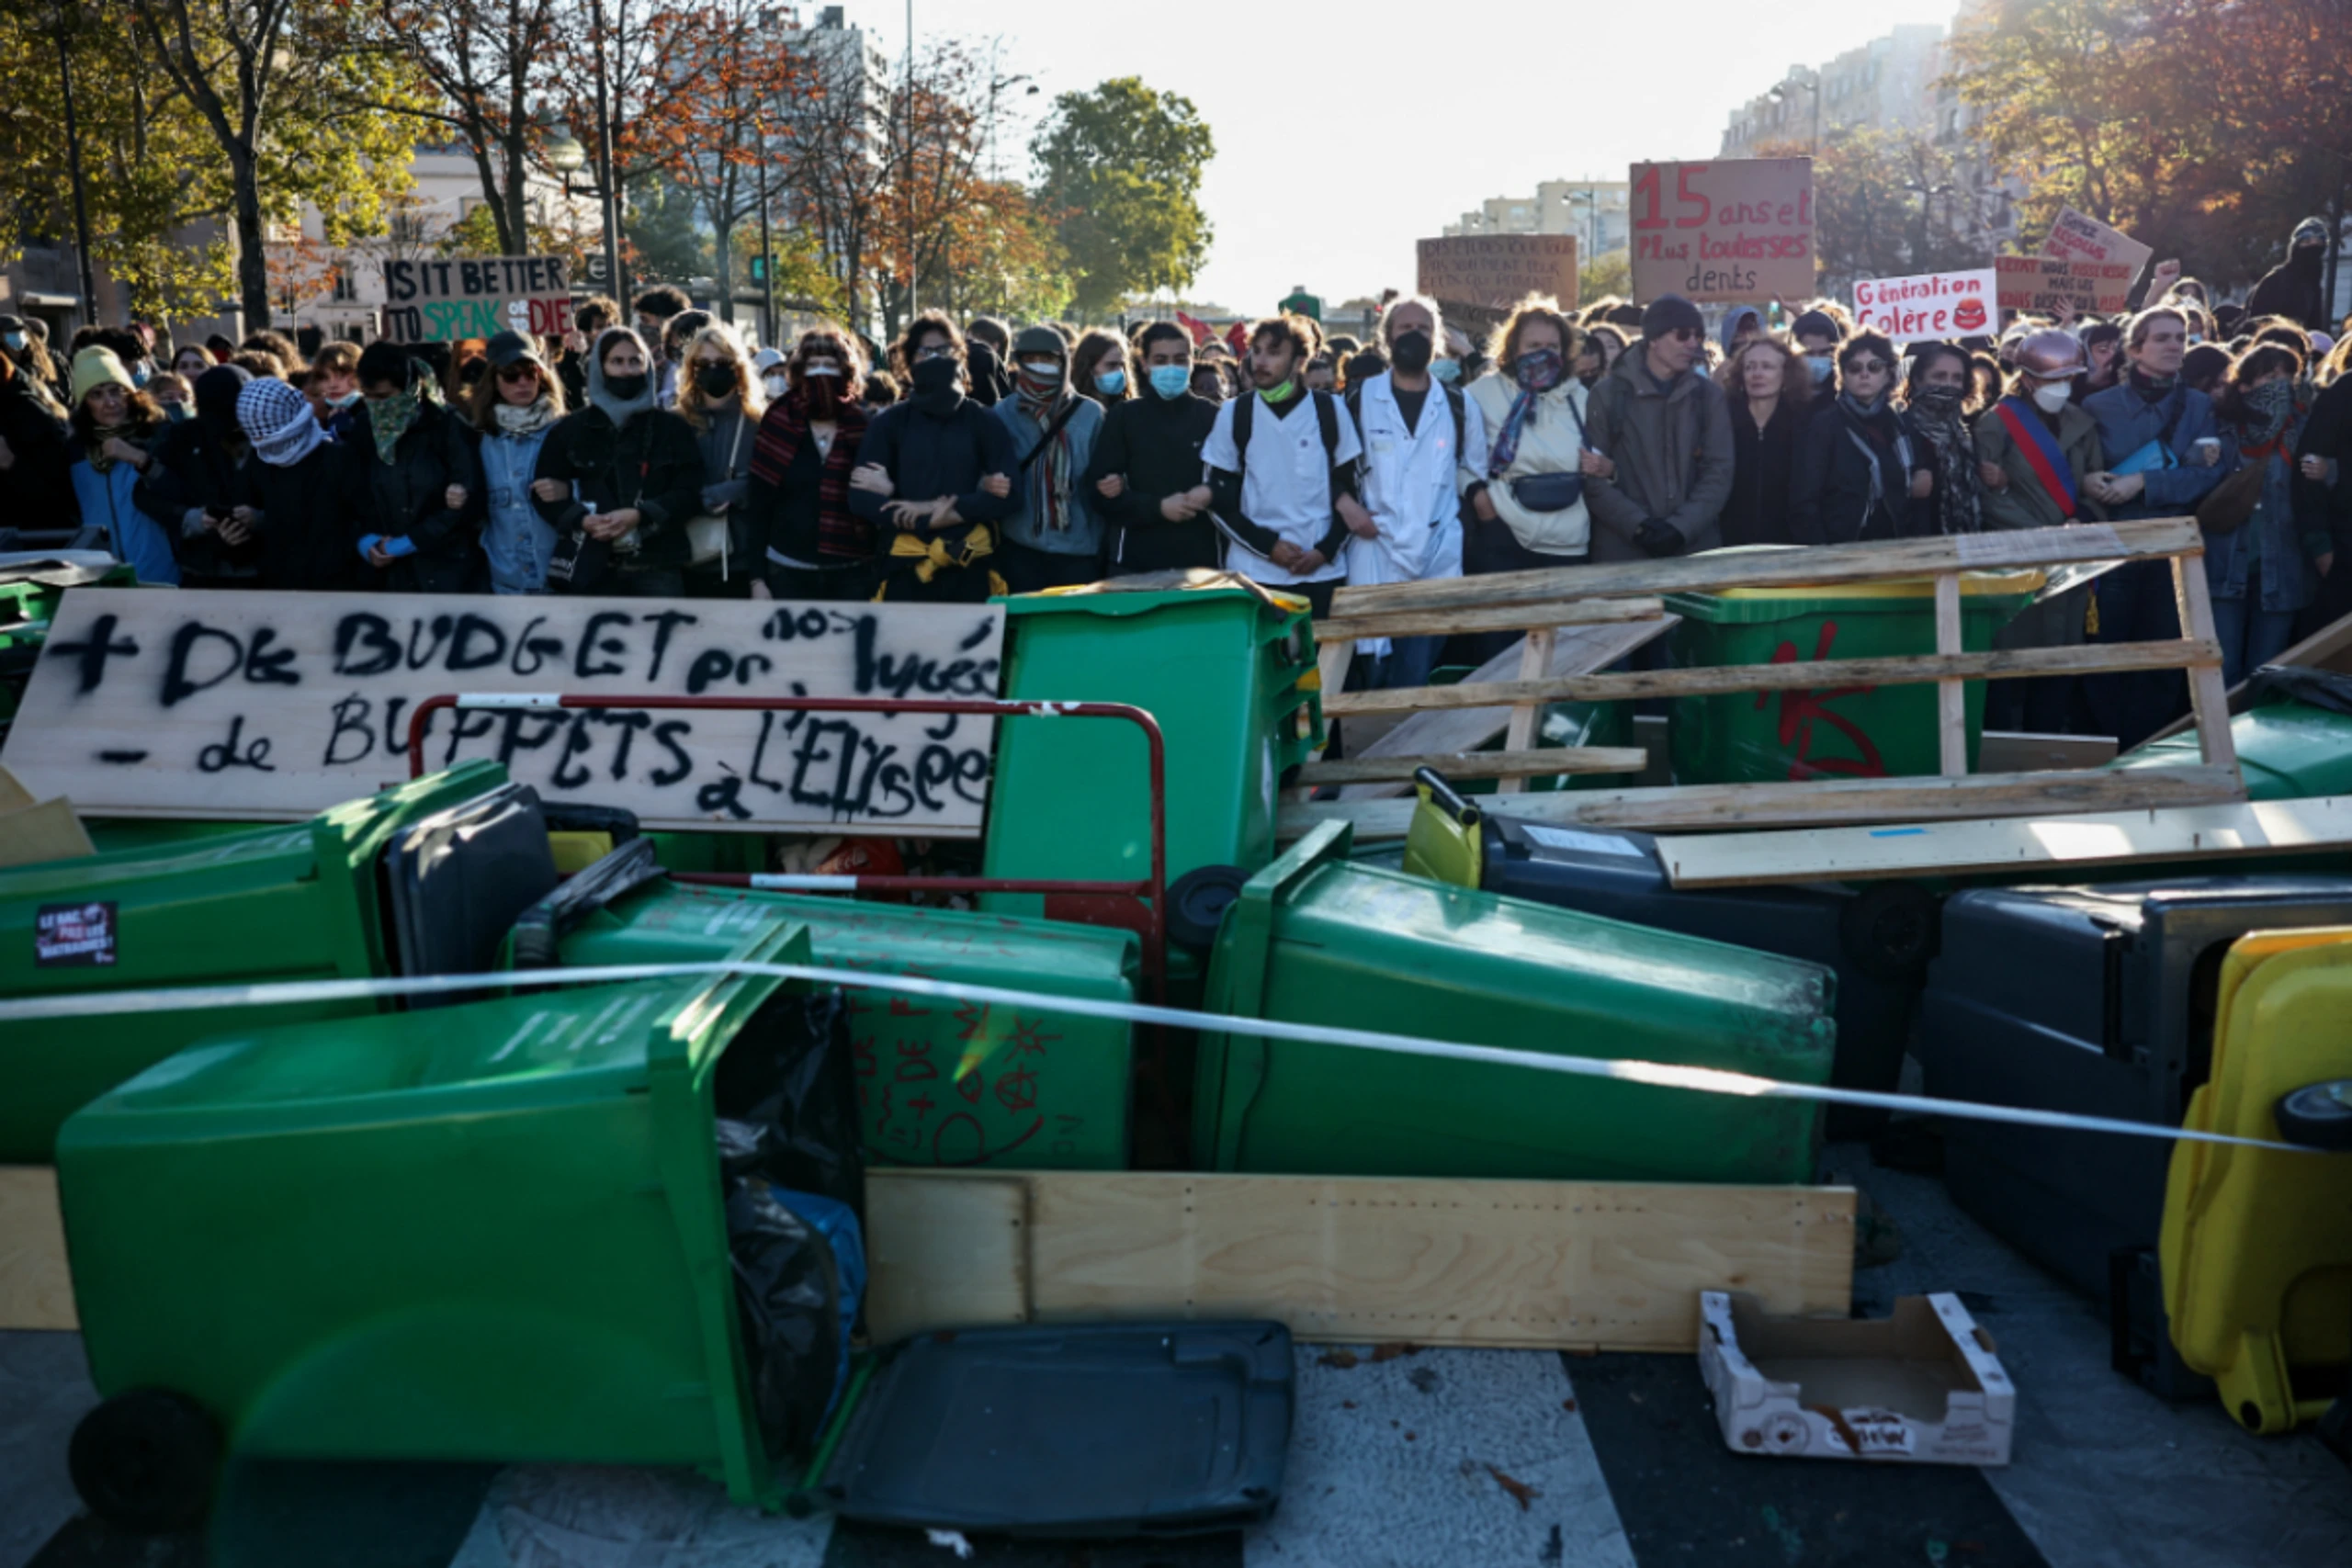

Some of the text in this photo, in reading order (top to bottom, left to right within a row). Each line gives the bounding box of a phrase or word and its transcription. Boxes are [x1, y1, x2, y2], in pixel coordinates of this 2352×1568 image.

[1635, 165, 1813, 229] 15 ans et
[1638, 234, 1689, 261] Plus
[384, 257, 565, 300] IS IT BETTER
[1685, 263, 1758, 291] dents
[389, 306, 423, 343] TO
[424, 299, 505, 342] SPEAK
[508, 300, 529, 315] OR
[529, 298, 574, 336] DIE
[1859, 305, 1948, 336] Colère
[333, 611, 697, 682] BUDGET
[196, 716, 276, 773] de
[696, 760, 753, 819] à
[895, 1040, 938, 1082] DE
